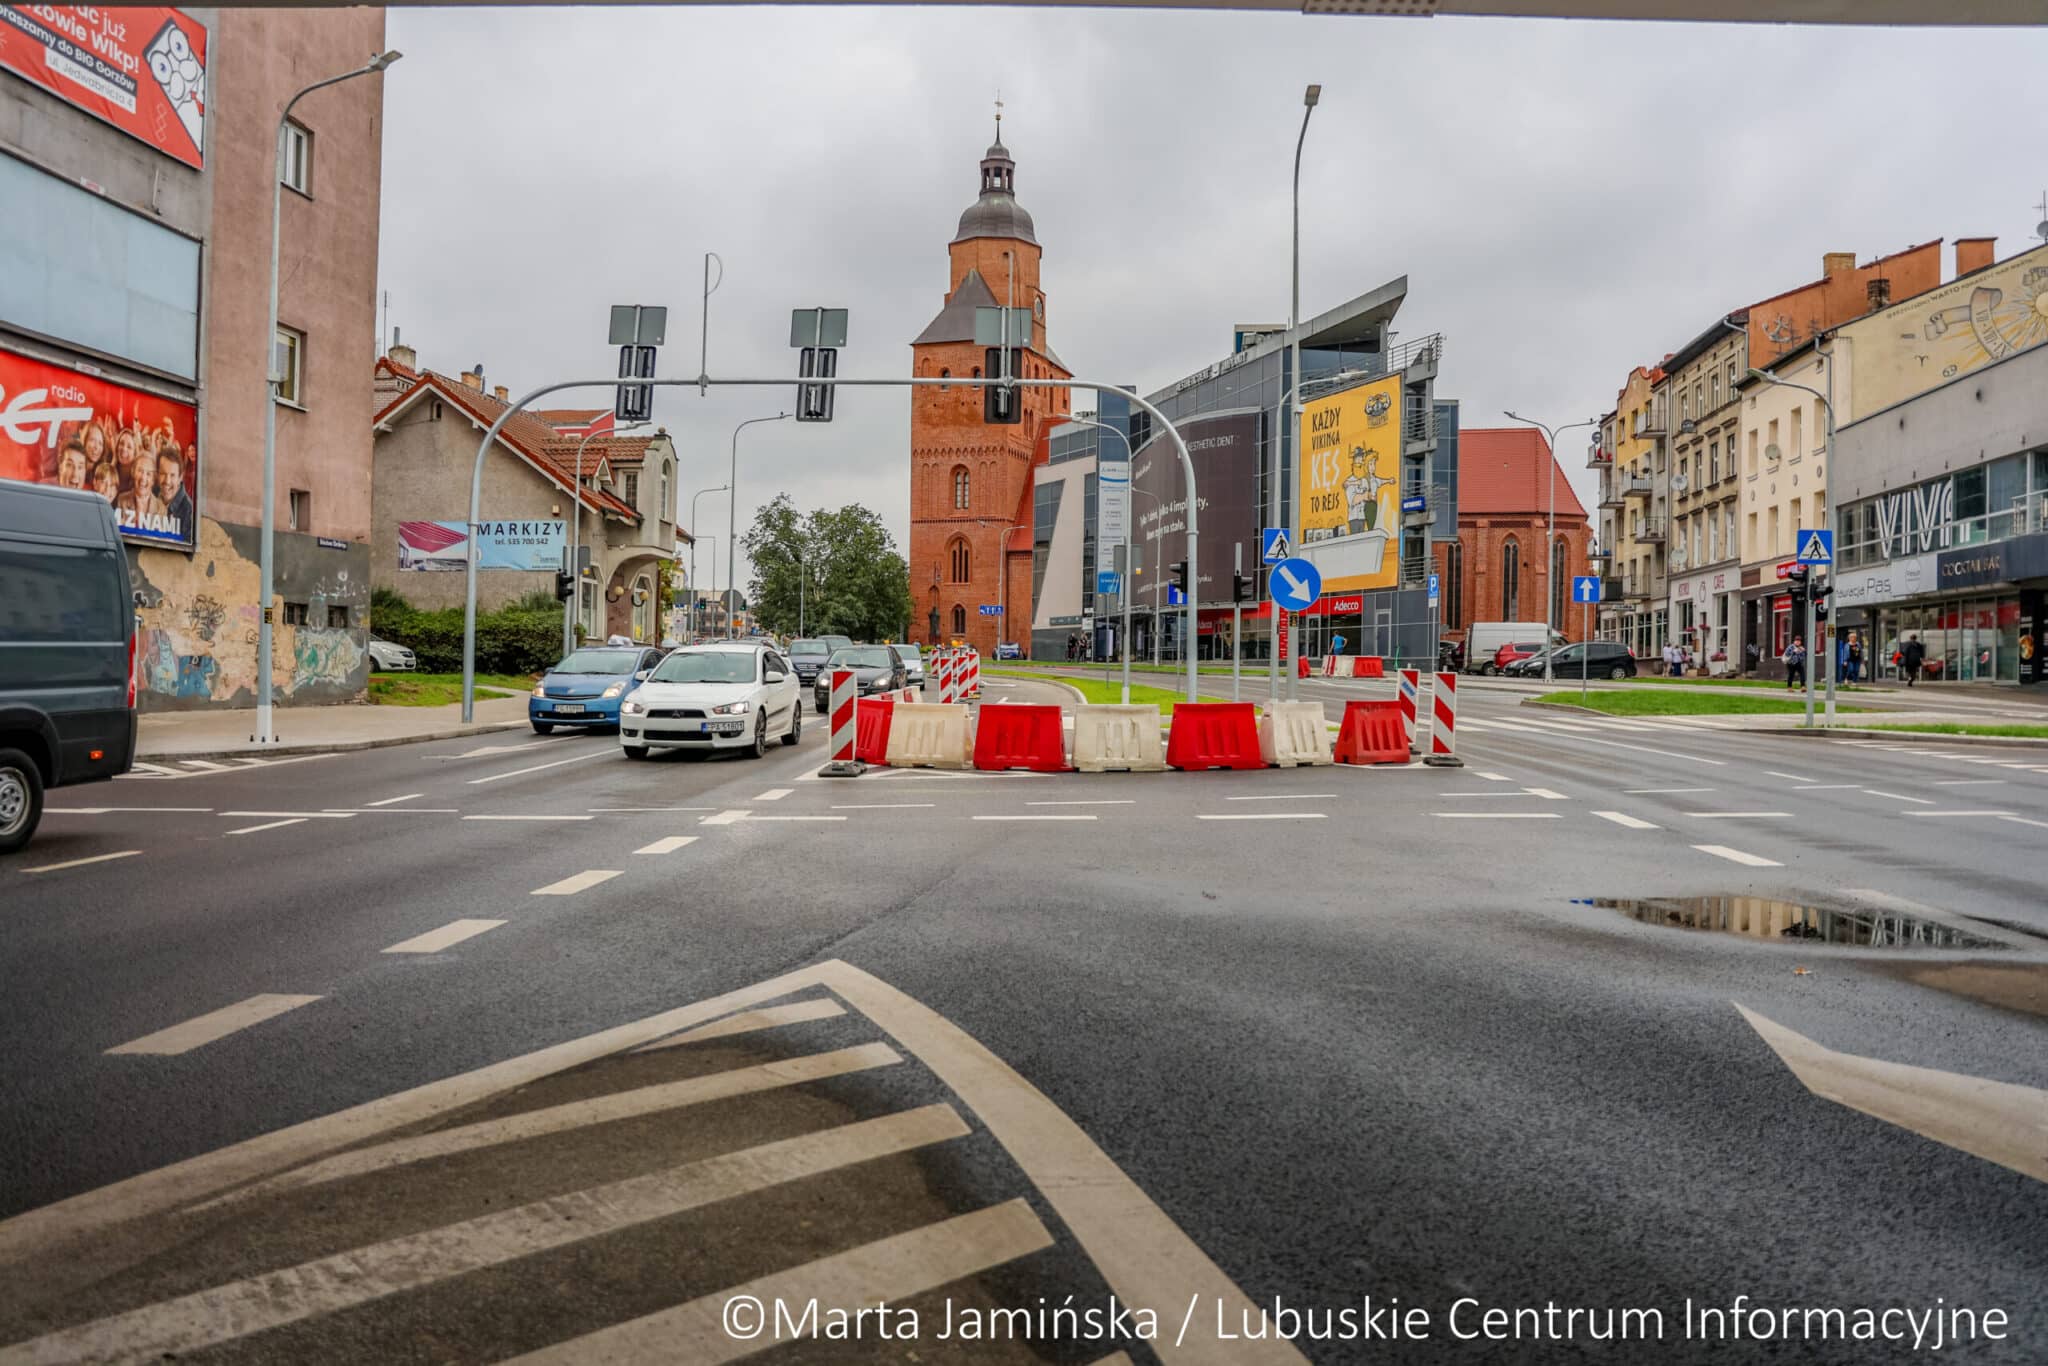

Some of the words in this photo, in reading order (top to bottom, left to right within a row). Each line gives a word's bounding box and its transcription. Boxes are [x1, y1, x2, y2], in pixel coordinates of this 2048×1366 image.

[102, 12, 126, 42] już
[91, 29, 139, 74] Wlkp!
[58, 40, 74, 56] do
[75, 48, 95, 68] BIG
[95, 61, 136, 91] Gorzów
[51, 384, 86, 404] radio
[1312, 407, 1341, 433] KAŻDY
[1312, 432, 1341, 450] VIKINGA
[1311, 450, 1340, 492] KĘS
[1310, 495, 1320, 514] TO
[1321, 493, 1340, 511] REJS
[139, 512, 182, 536] NAMI
[477, 522, 563, 536] MARKIZY
[1334, 600, 1360, 612] Adecco
